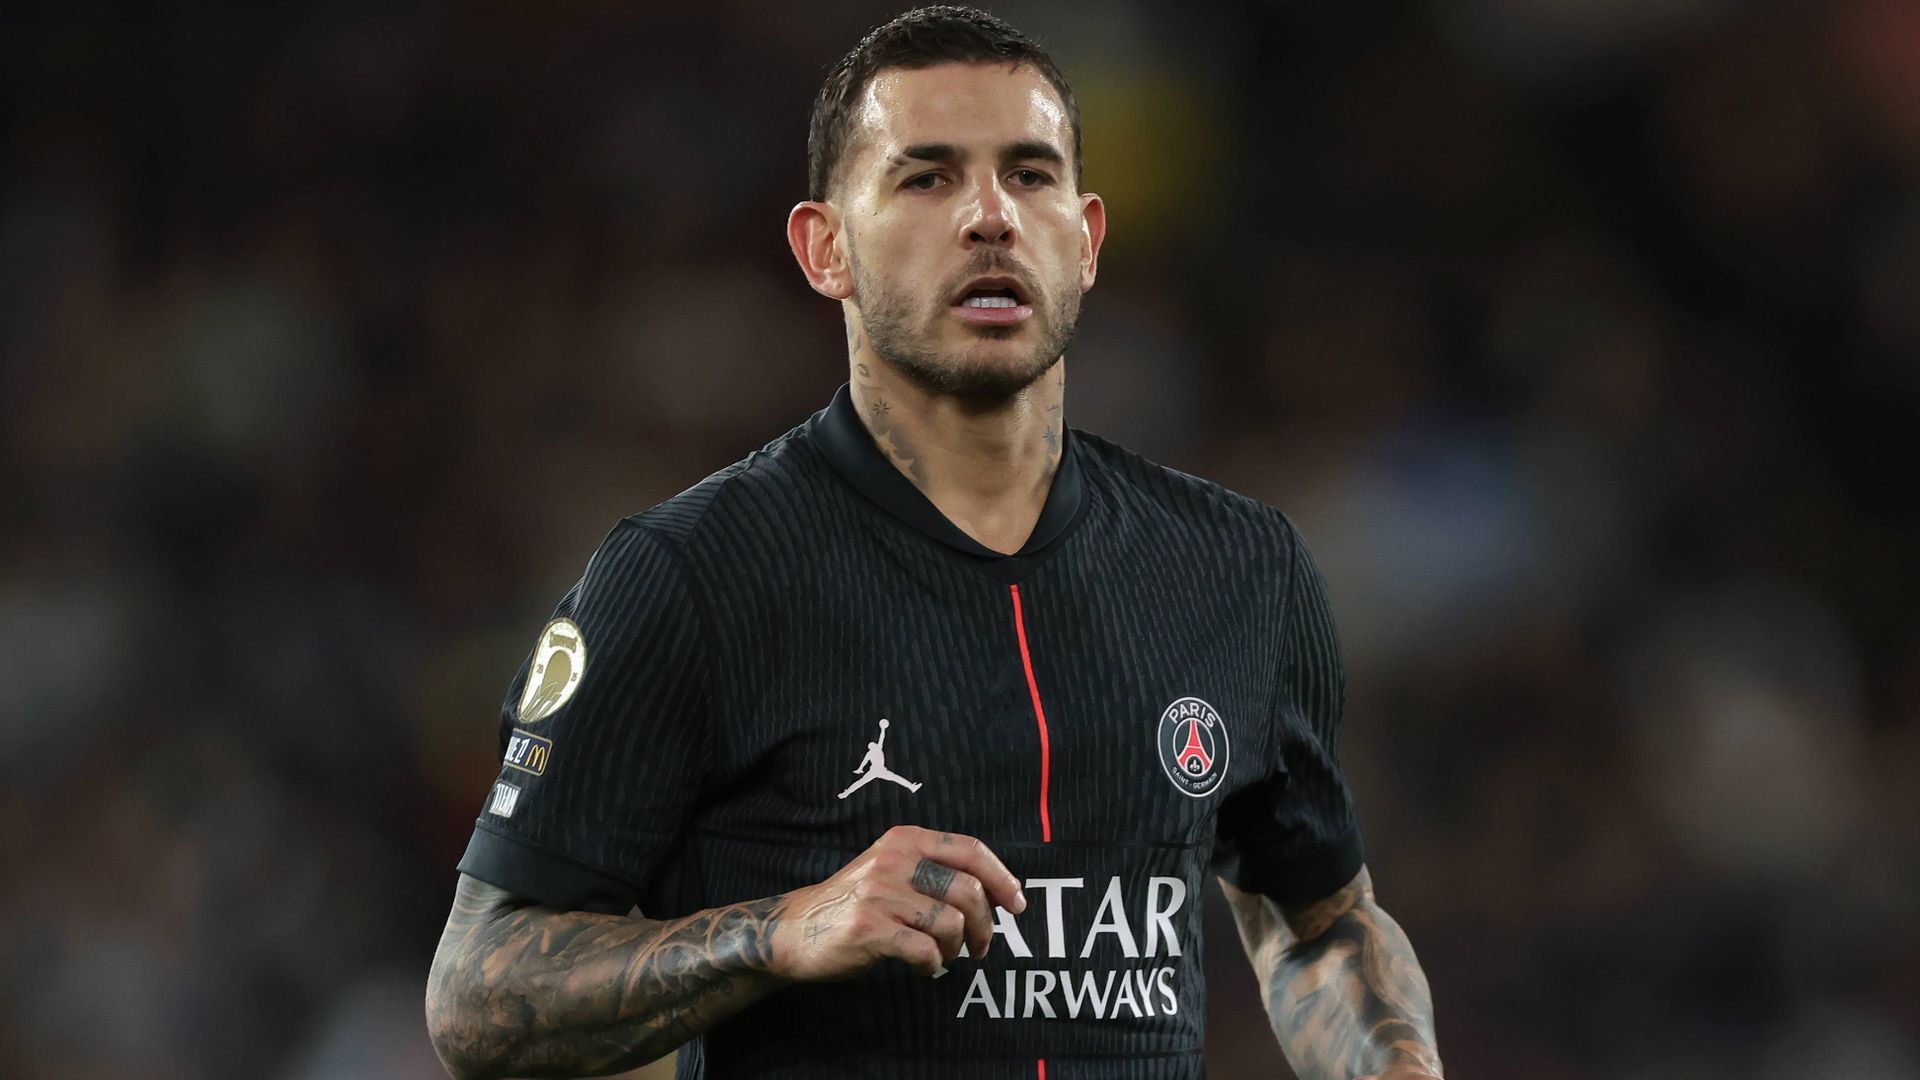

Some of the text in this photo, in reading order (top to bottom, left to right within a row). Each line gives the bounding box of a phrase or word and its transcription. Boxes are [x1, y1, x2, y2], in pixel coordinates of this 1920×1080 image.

[1168, 703, 1216, 728] PARIS
[1171, 766, 1189, 785] SAINT
[932, 876, 1187, 978] ATAR
[956, 967, 1176, 1019] AIRWAYS
